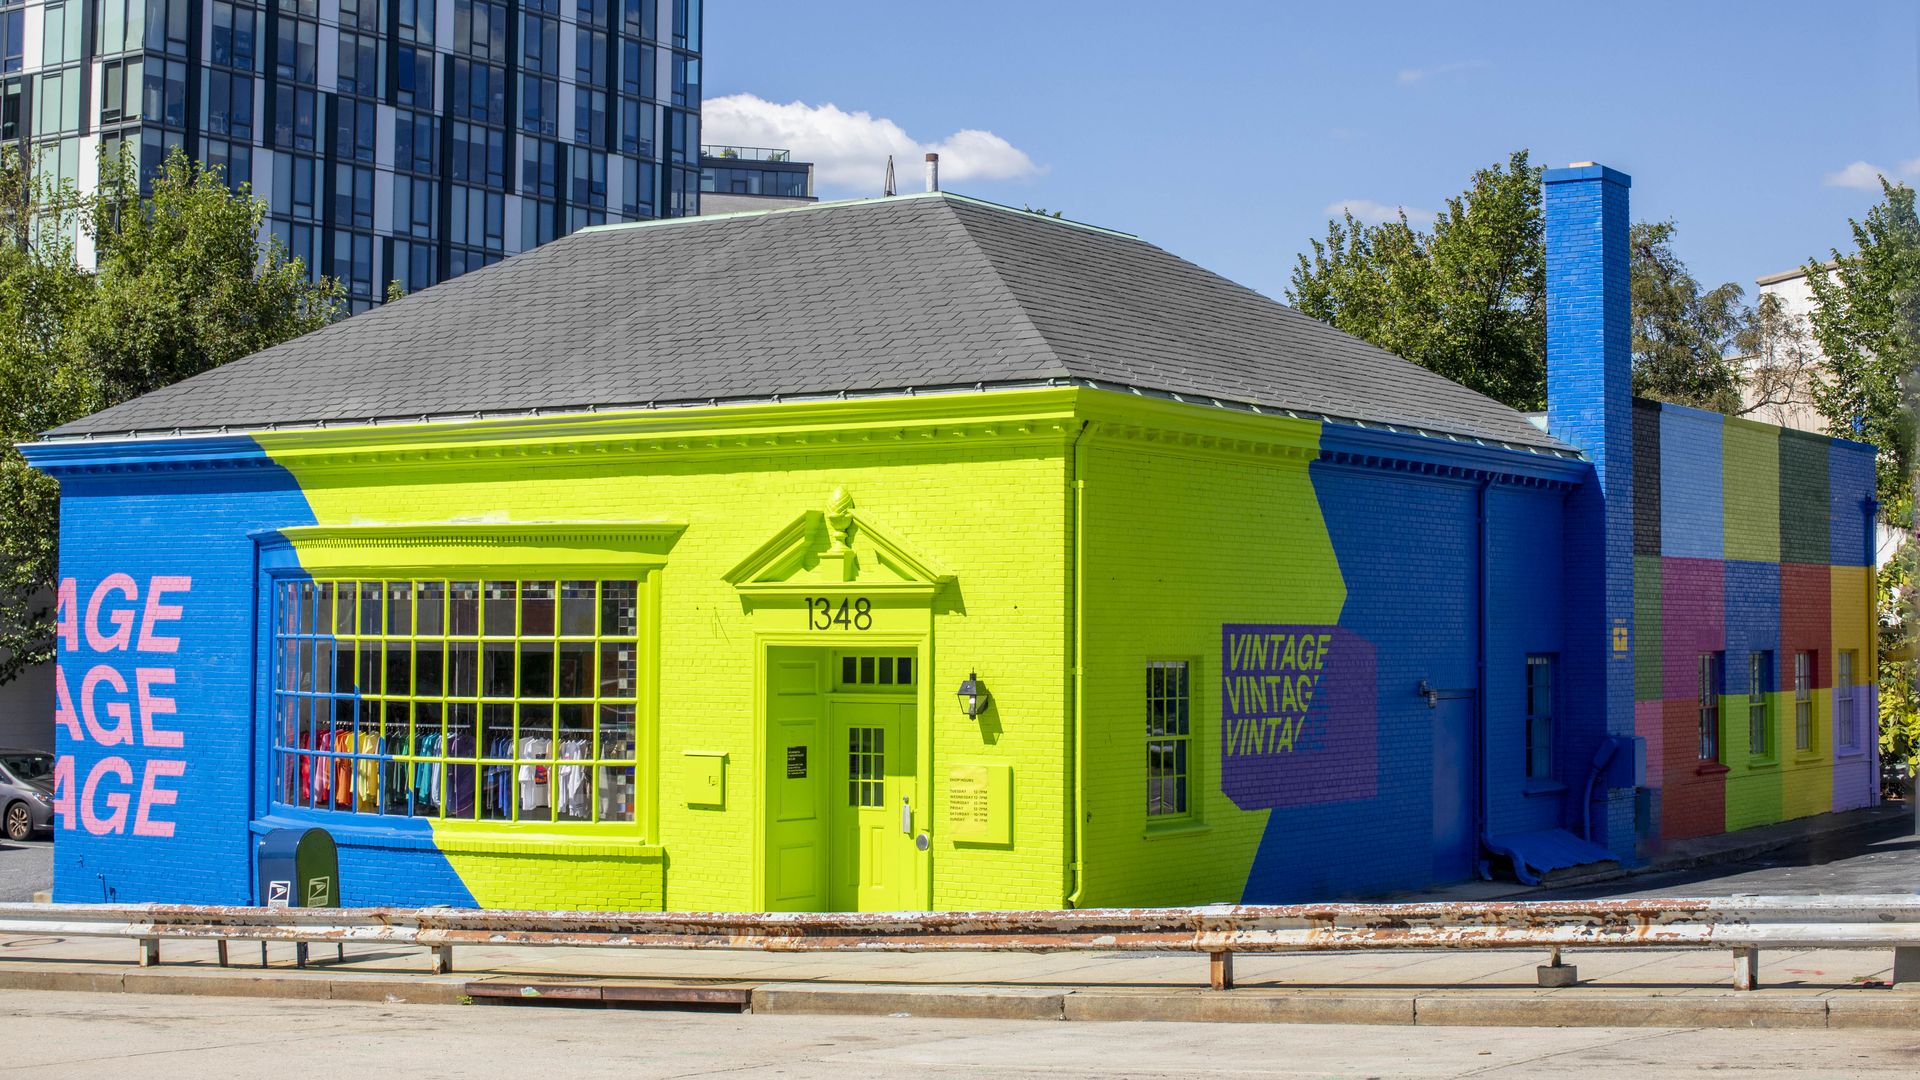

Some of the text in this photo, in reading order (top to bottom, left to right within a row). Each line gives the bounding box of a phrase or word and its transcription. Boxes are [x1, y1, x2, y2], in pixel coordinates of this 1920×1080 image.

[805, 597, 872, 631] 1348
[1229, 634, 1332, 671] VINTAGE
[1225, 674, 1328, 714] VINTAG
[1226, 715, 1327, 757] VINTA
